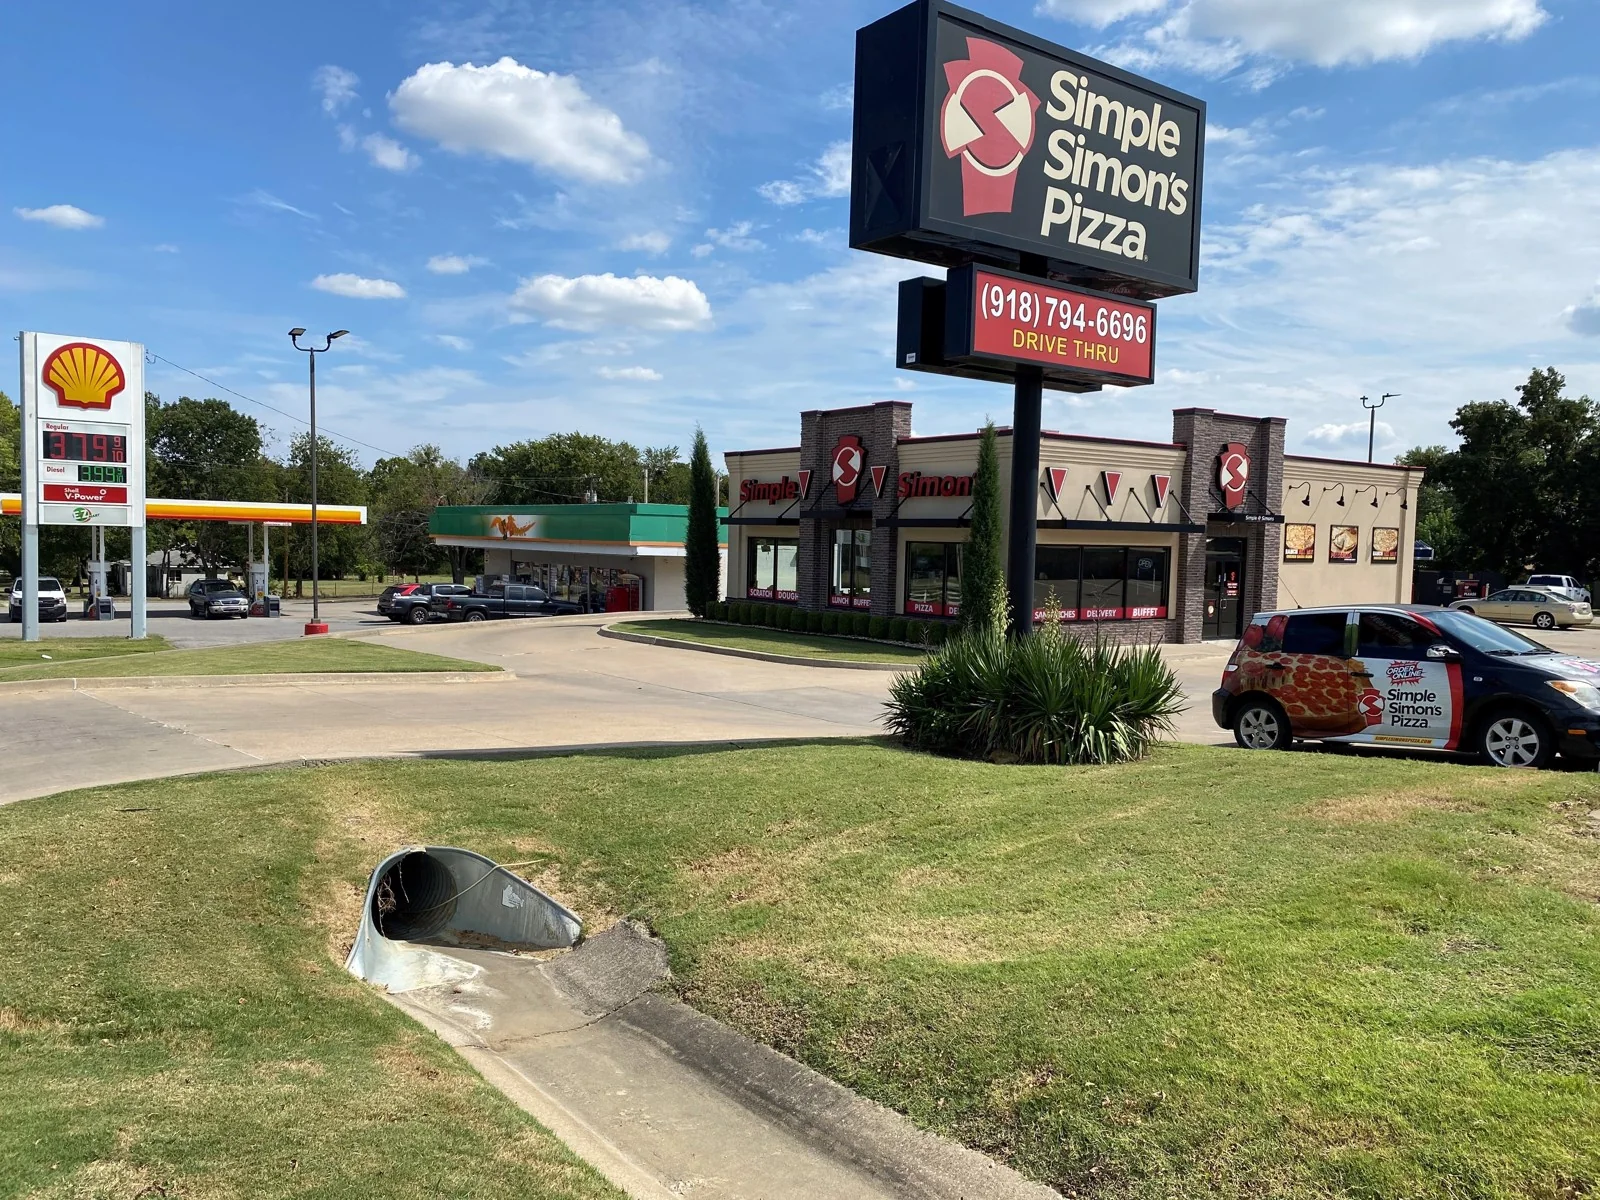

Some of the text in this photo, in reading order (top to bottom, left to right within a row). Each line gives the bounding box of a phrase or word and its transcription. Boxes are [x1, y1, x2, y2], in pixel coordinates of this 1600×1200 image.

[1046, 70, 1181, 158] Simple
[1043, 129, 1189, 215] Simon's
[1040, 186, 1147, 261] Pizza
[981, 282, 1147, 344] (918) 794-6696
[1012, 329, 1119, 364] DRIVE THRU
[45, 423, 69, 431] Regular
[64, 493, 104, 501] V-Power
[740, 476, 797, 505] Simple
[750, 588, 773, 598] SCRATCH
[831, 595, 850, 606] LUNCH
[914, 603, 934, 613] PIZZA
[1132, 607, 1158, 617] BUFFET
[1386, 665, 1415, 675] ORDER
[1392, 670, 1423, 680] ONLINE
[1387, 689, 1437, 704] Simple
[1389, 702, 1442, 716] Simon's
[1391, 715, 1429, 729] Pizza
